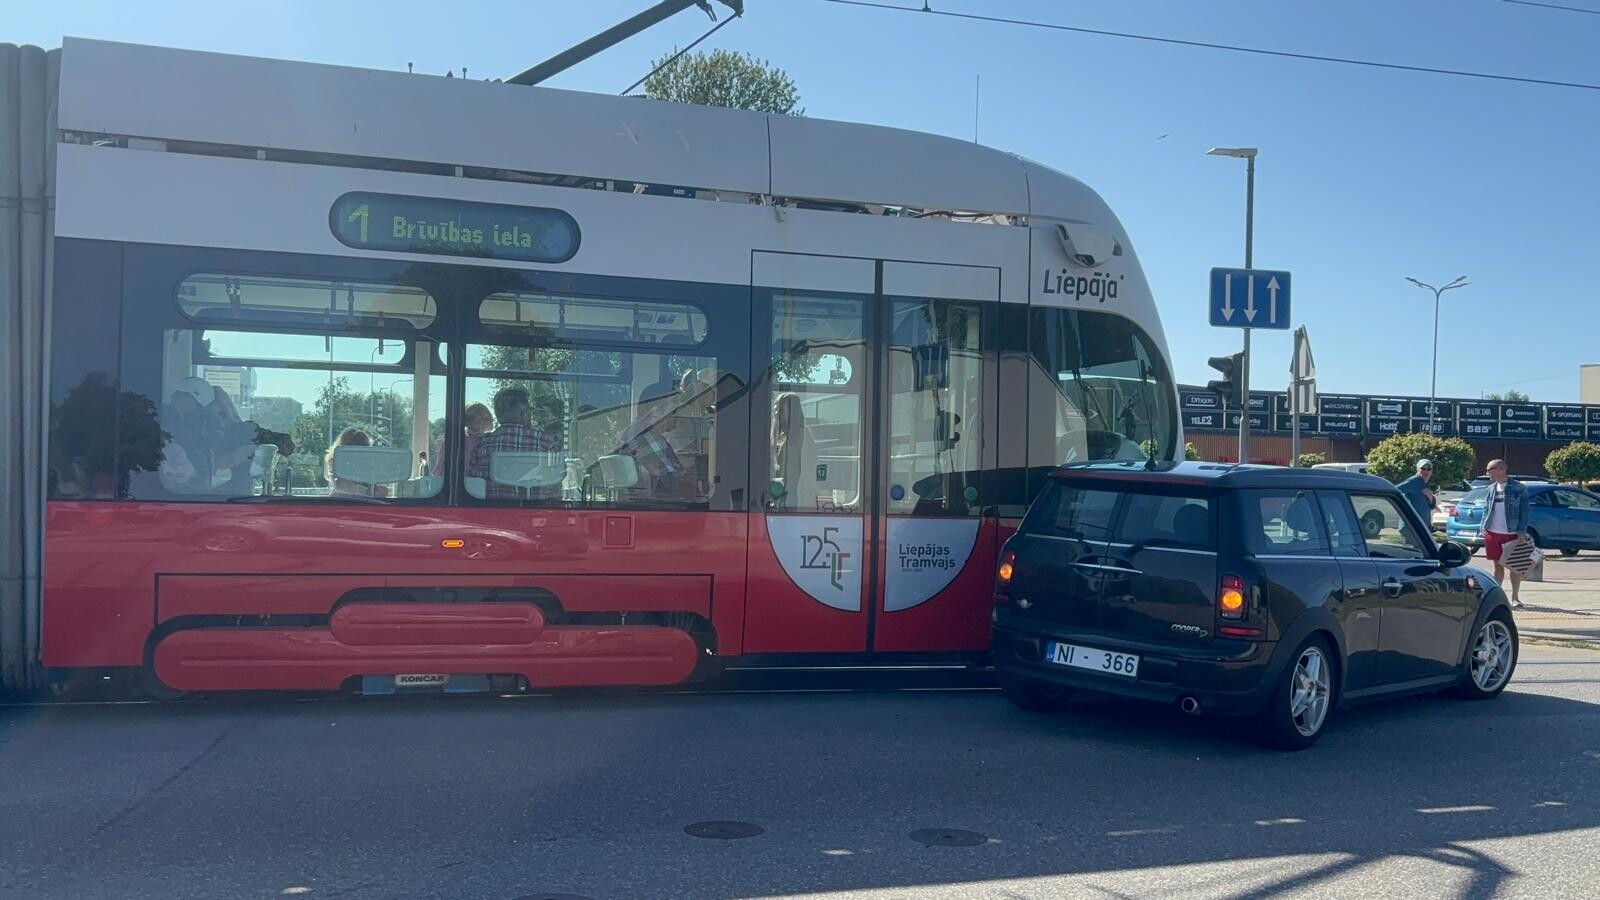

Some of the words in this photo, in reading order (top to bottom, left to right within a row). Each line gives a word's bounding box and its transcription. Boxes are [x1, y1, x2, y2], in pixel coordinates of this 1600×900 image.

[348, 204, 369, 244] 1
[392, 215, 484, 245] Brīvības
[493, 224, 532, 249] iela
[1043, 267, 1118, 304] Liepāja
[1191, 415, 1213, 425] TELE2
[899, 543, 951, 557] Liepājas
[899, 555, 956, 571] Tramvajs
